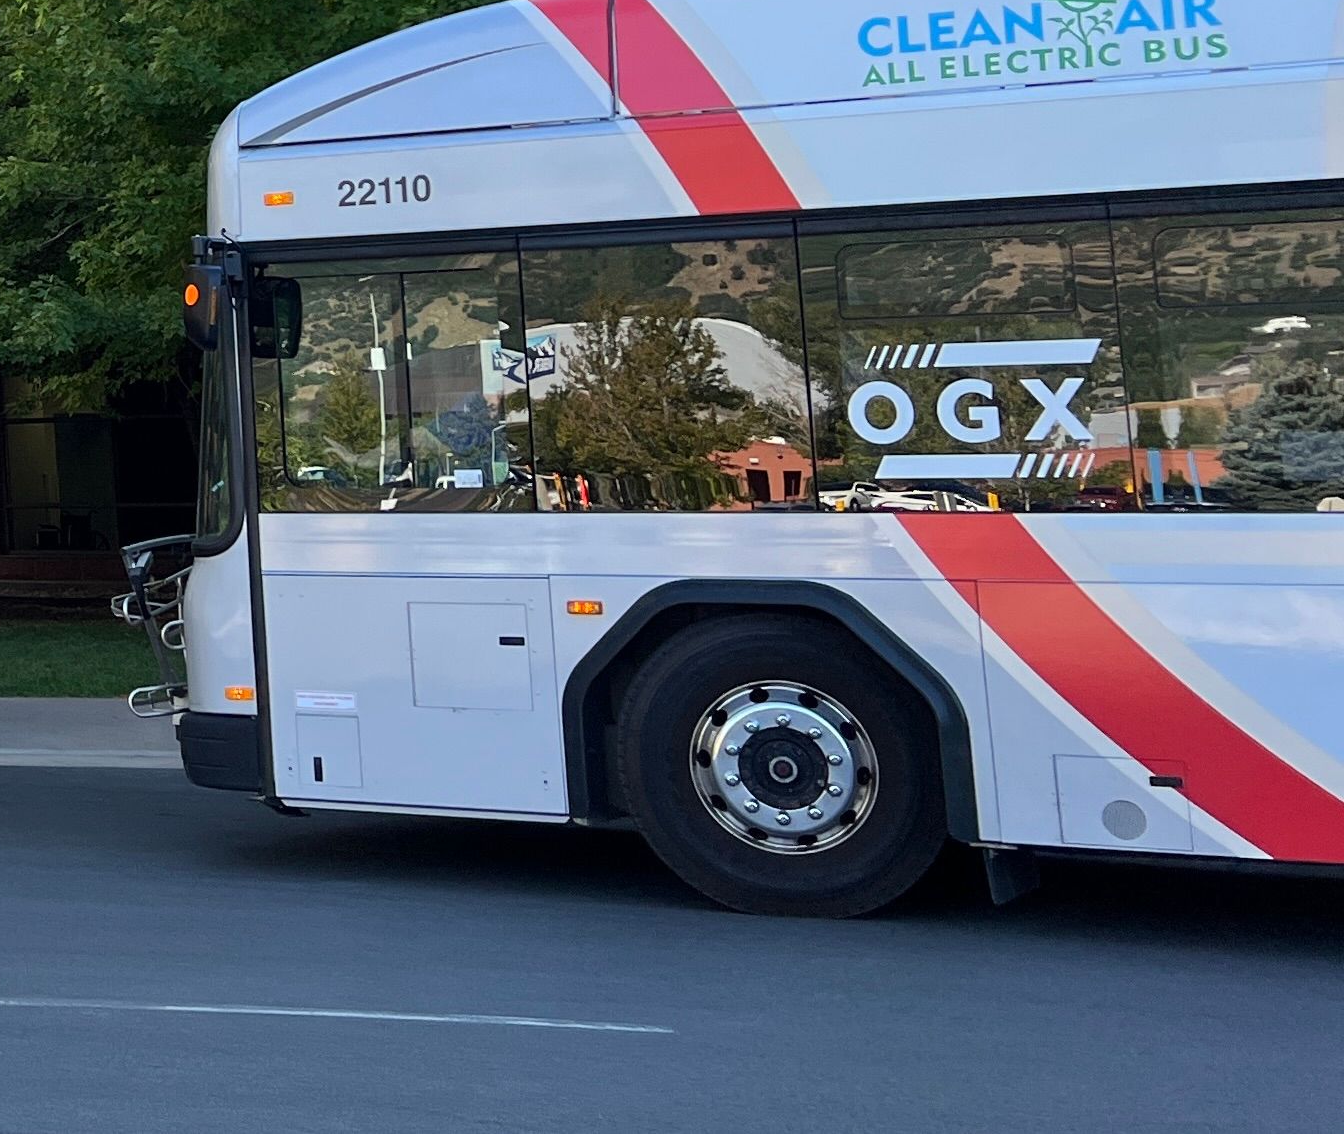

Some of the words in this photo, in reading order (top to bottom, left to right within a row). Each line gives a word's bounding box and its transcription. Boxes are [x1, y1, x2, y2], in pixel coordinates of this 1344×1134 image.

[857, 2, 1044, 57] CLEAN
[862, 61, 925, 87] ALL
[940, 42, 1122, 80] ELECTRIC
[1143, 33, 1229, 64] BUS
[338, 174, 431, 207] 22110
[847, 377, 1095, 445] OGX
